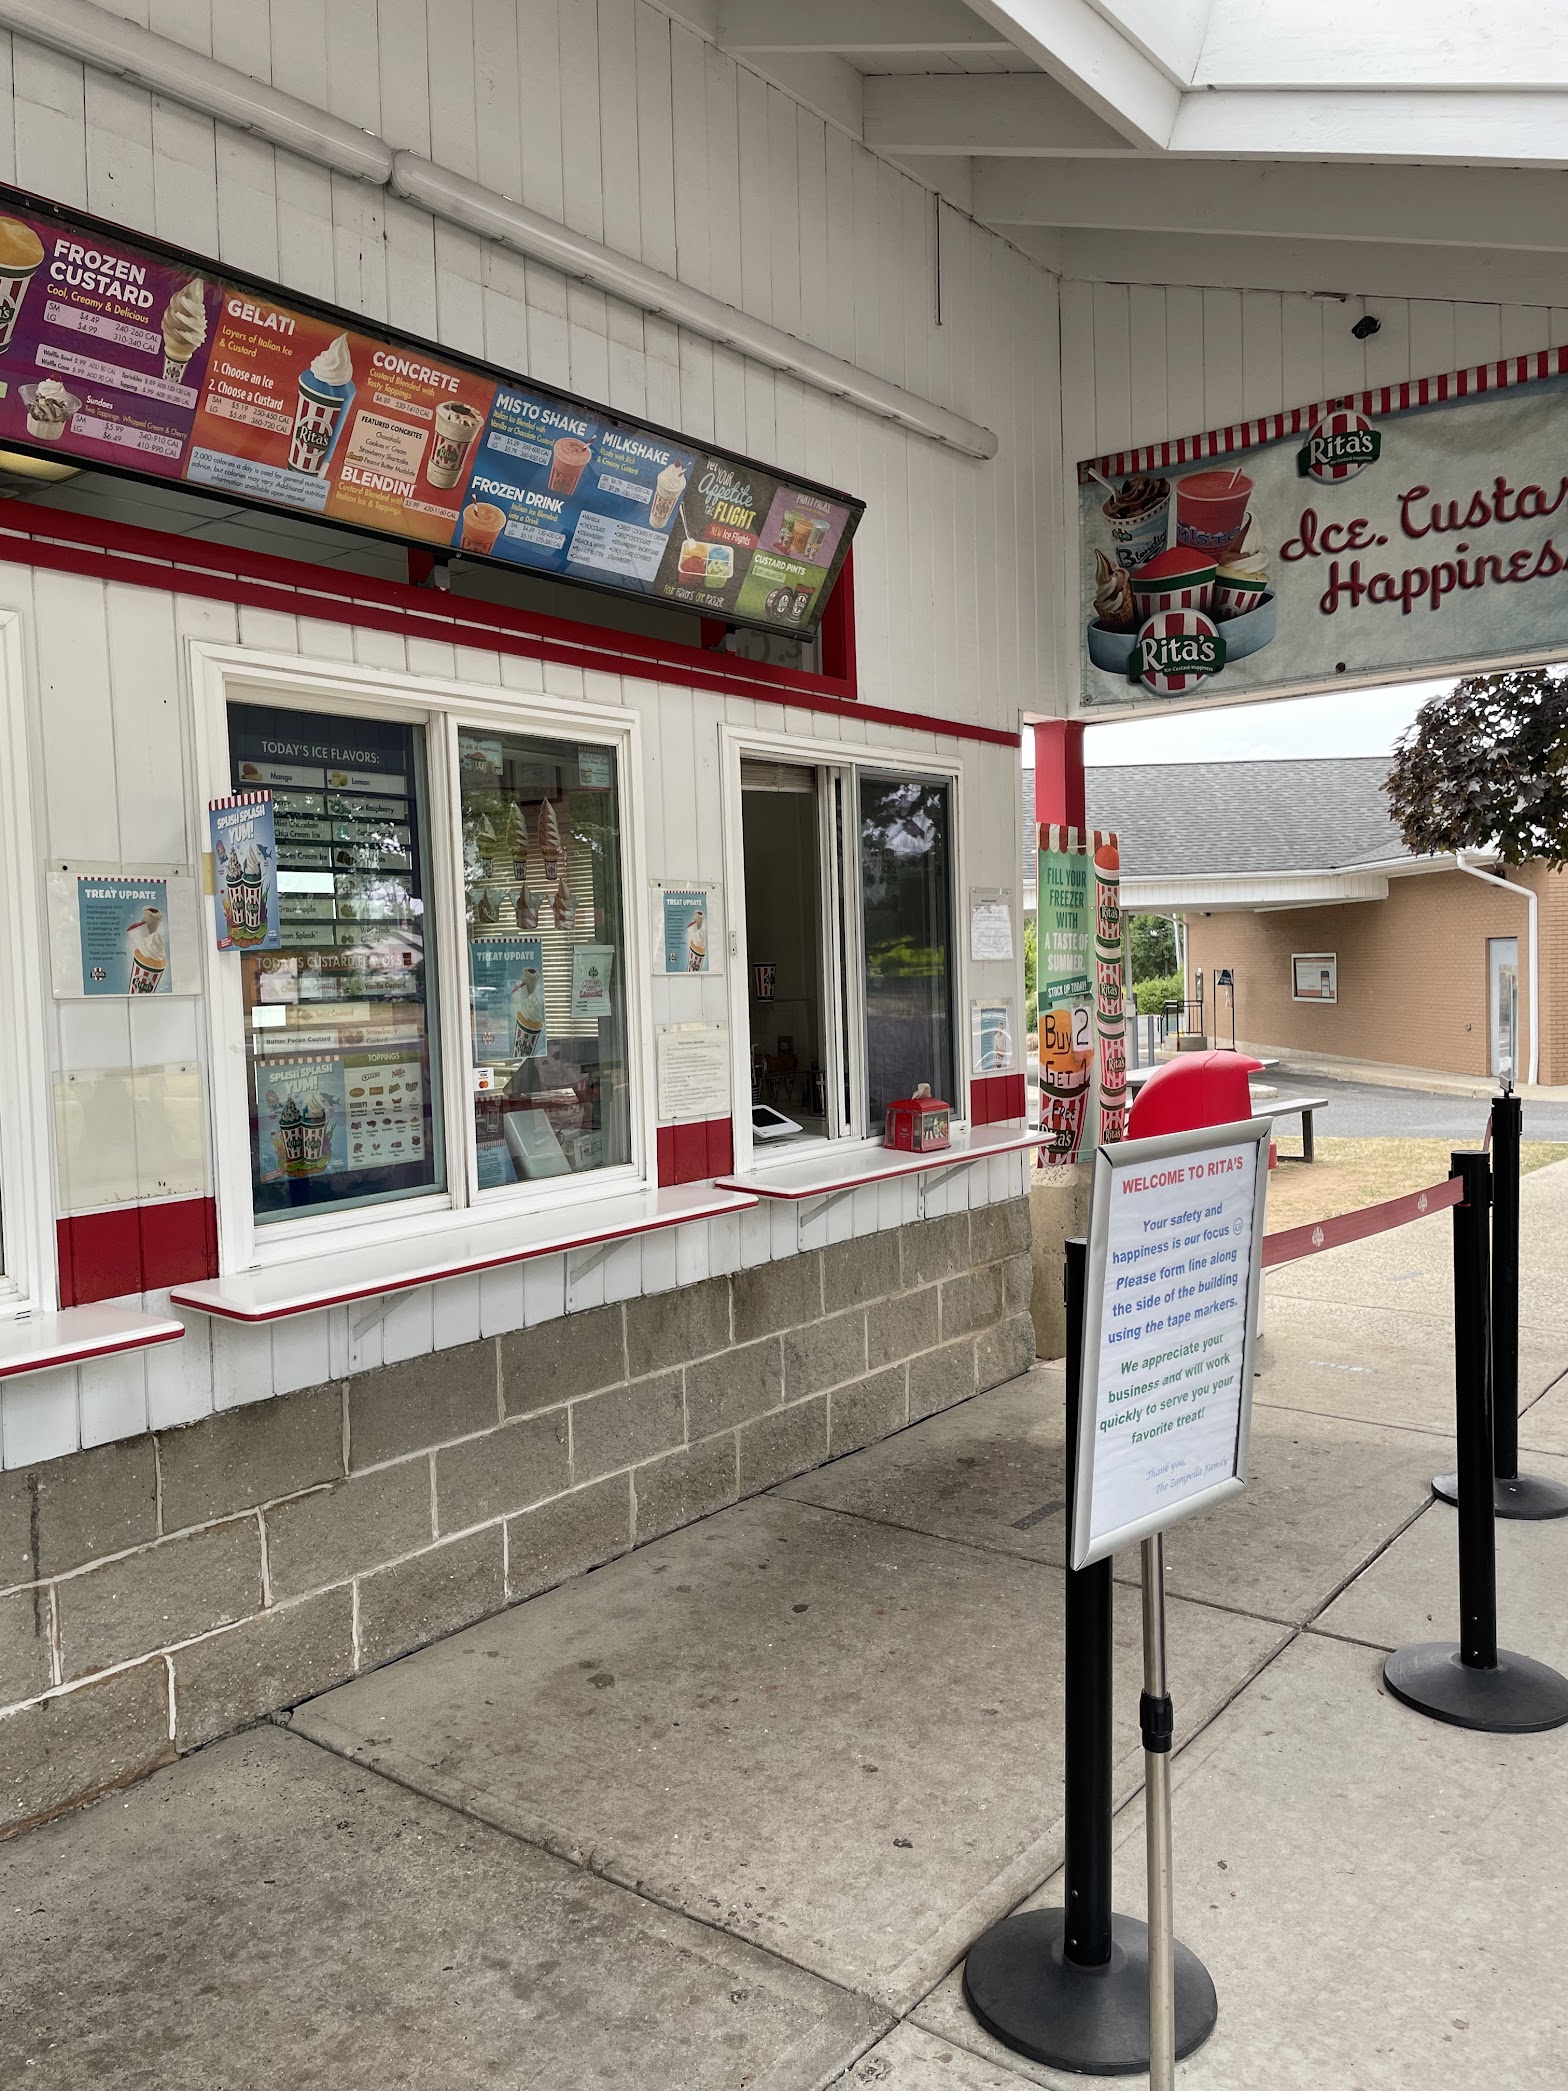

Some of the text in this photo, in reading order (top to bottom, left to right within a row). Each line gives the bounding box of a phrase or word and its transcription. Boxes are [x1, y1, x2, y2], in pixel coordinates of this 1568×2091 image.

[54, 239, 146, 285] FROZEN
[50, 262, 153, 308] CUSTARD
[47, 284, 149, 324] Cool, Creamy & Delicious
[227, 299, 296, 336] GELATI
[46, 313, 57, 322] LG
[78, 323, 98, 333] $4.99
[143, 342, 156, 352] CAL
[49, 303, 61, 312] SM
[80, 312, 100, 323] $4.49
[145, 332, 158, 342] CAL
[219, 338, 258, 358] & Custard
[222, 325, 247, 341] Layers
[258, 337, 281, 352] Italian
[282, 346, 293, 356] Ice
[213, 360, 274, 389] 1. Choose an Ice
[369, 368, 435, 397] Custard Blended with
[373, 351, 460, 394] CONCRETE
[86, 395, 114, 410] Sundaes
[208, 379, 284, 411] 2. Choose a Custard
[366, 378, 412, 400] Tasty Toppings
[362, 416, 424, 440] FEATURED CONCRETES
[496, 393, 588, 436] MISTO SHAKE
[299, 426, 329, 447] Rita's
[602, 432, 670, 466] MILKSHAKE
[1310, 430, 1373, 465] Rita's
[194, 451, 213, 462] 2,000
[213, 456, 235, 469] calories
[242, 464, 253, 473] day
[260, 468, 273, 478] used
[273, 471, 282, 480] for
[283, 475, 304, 487] general
[304, 480, 326, 491] nutrition
[340, 466, 415, 498] BLENDINI
[336, 491, 359, 504] Italian
[374, 501, 402, 515] Toppings
[471, 476, 565, 514] FROZEN DRINK
[698, 472, 753, 507] Appetite
[713, 502, 756, 530] FLIGHT
[710, 526, 751, 546] NEW Ice Flights
[1279, 507, 1389, 562] Ice.
[754, 554, 786, 570] CUSTARD
[786, 562, 806, 576] PINTS
[1320, 538, 1568, 615] Happines
[1140, 635, 1216, 671] Rita's
[262, 741, 380, 764] TODAY'S ICE FLAVORS:
[270, 772, 293, 782] Mango
[352, 778, 370, 787] Lemon
[217, 804, 266, 830] SPLISH SPLASH
[365, 804, 394, 814] Raspberry
[229, 821, 254, 845] YUM!
[1047, 868, 1087, 888] FILL YOUR
[85, 889, 156, 900] TREAT UPDATE
[1050, 890, 1084, 908] FREEZER
[1056, 912, 1078, 929] WITH
[1101, 905, 1119, 920] Rita's
[477, 951, 535, 961] TREAT UPDATE
[1044, 932, 1089, 951] A TASTE OF
[1047, 953, 1086, 972] SUMMER.
[1048, 981, 1087, 998] STOCK UP TODAY!
[1101, 983, 1118, 996] Rita's
[1045, 1014, 1072, 1055] Buy
[1074, 1008, 1089, 1046] 2
[368, 1052, 400, 1062] TOPPINGS
[1108, 1057, 1125, 1071] Rita's
[284, 1076, 318, 1095] YUM!
[1078, 1059, 1090, 1088] 1
[1105, 1128, 1120, 1141] Rita's
[1122, 1157, 1243, 1195] WELCOME TO RITA'S
[1143, 1202, 1222, 1232] Your safety and
[1112, 1225, 1230, 1265] happiness is our focus
[1116, 1249, 1237, 1291] Please form line along
[1112, 1272, 1238, 1317] the side of the building
[1108, 1297, 1238, 1344] using the tape markers.
[1121, 1333, 1224, 1375] We appreciate your
[1108, 1352, 1231, 1404] business and will work
[1099, 1376, 1234, 1433] quickly to serve you your
[1131, 1407, 1206, 1445] favorite treat!
